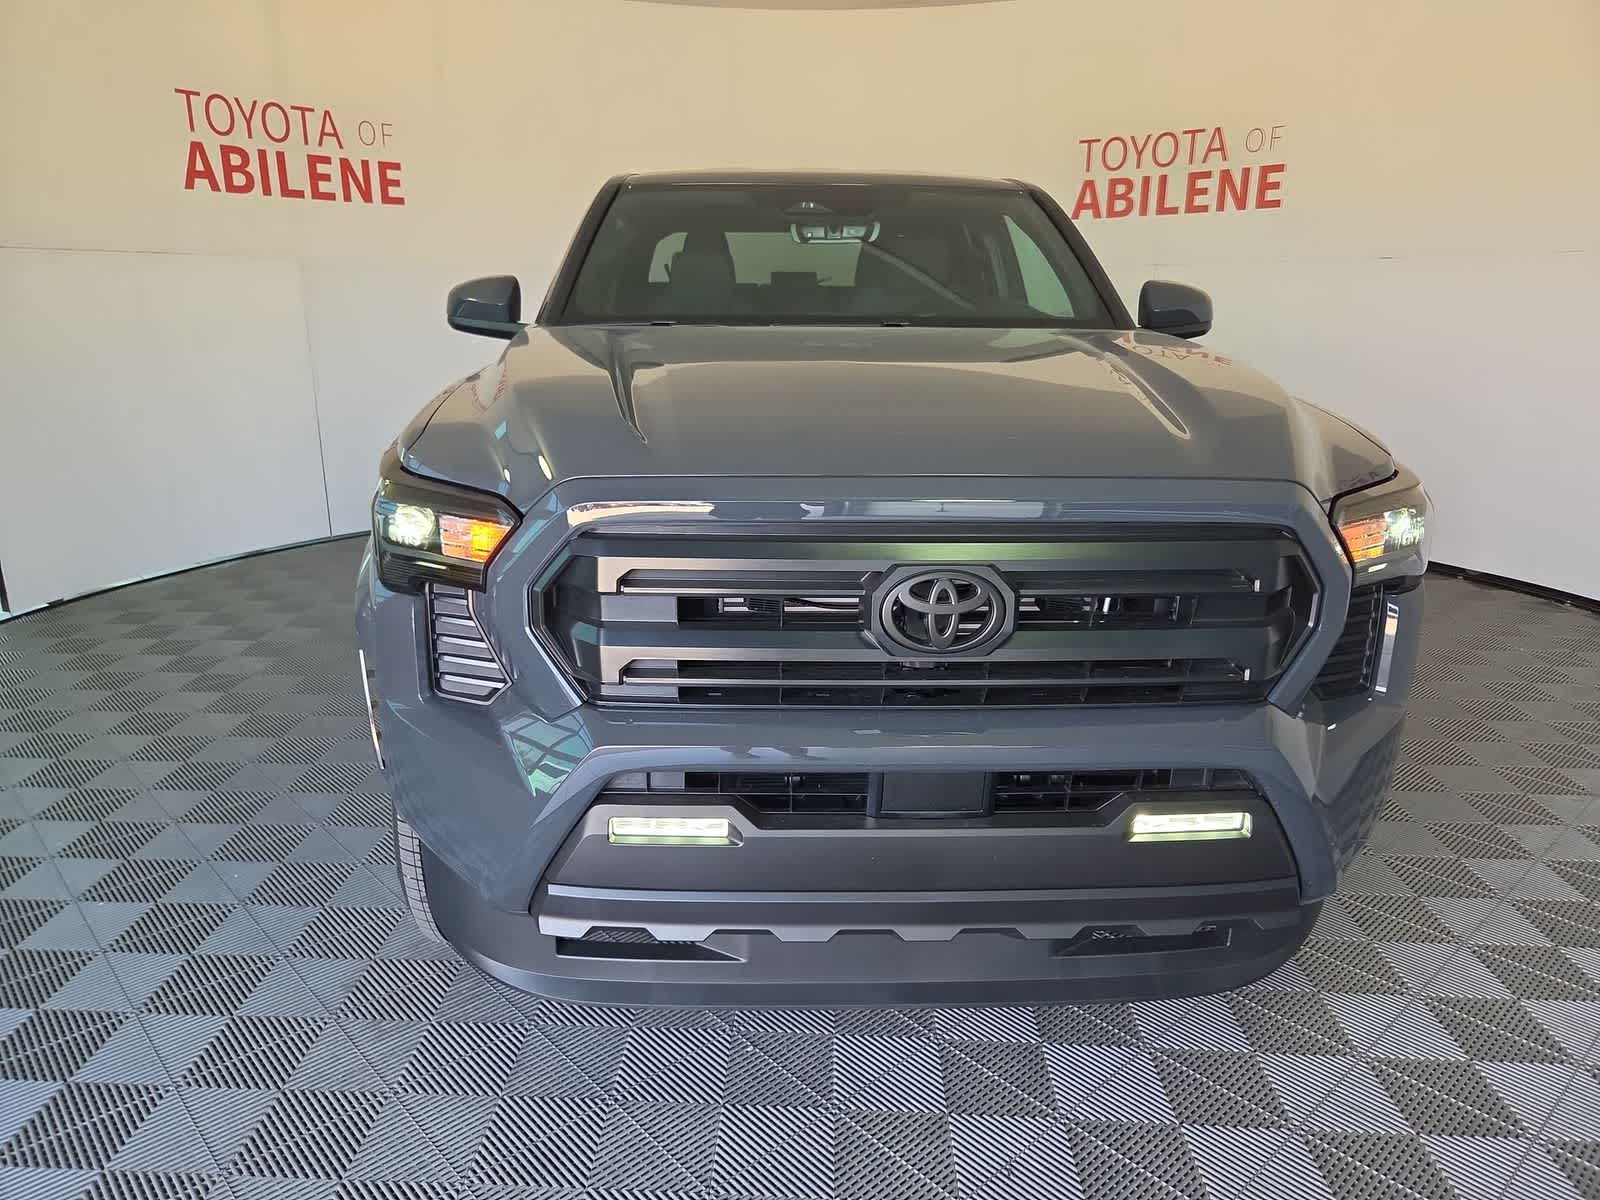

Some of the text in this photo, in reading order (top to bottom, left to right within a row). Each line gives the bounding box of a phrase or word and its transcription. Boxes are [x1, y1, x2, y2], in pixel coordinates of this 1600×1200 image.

[174, 88, 393, 149] TOYOTA OF
[184, 140, 406, 206] ABILENE
[1079, 125, 1286, 173] TOYOTA OF
[1071, 163, 1286, 220] ABILENE
